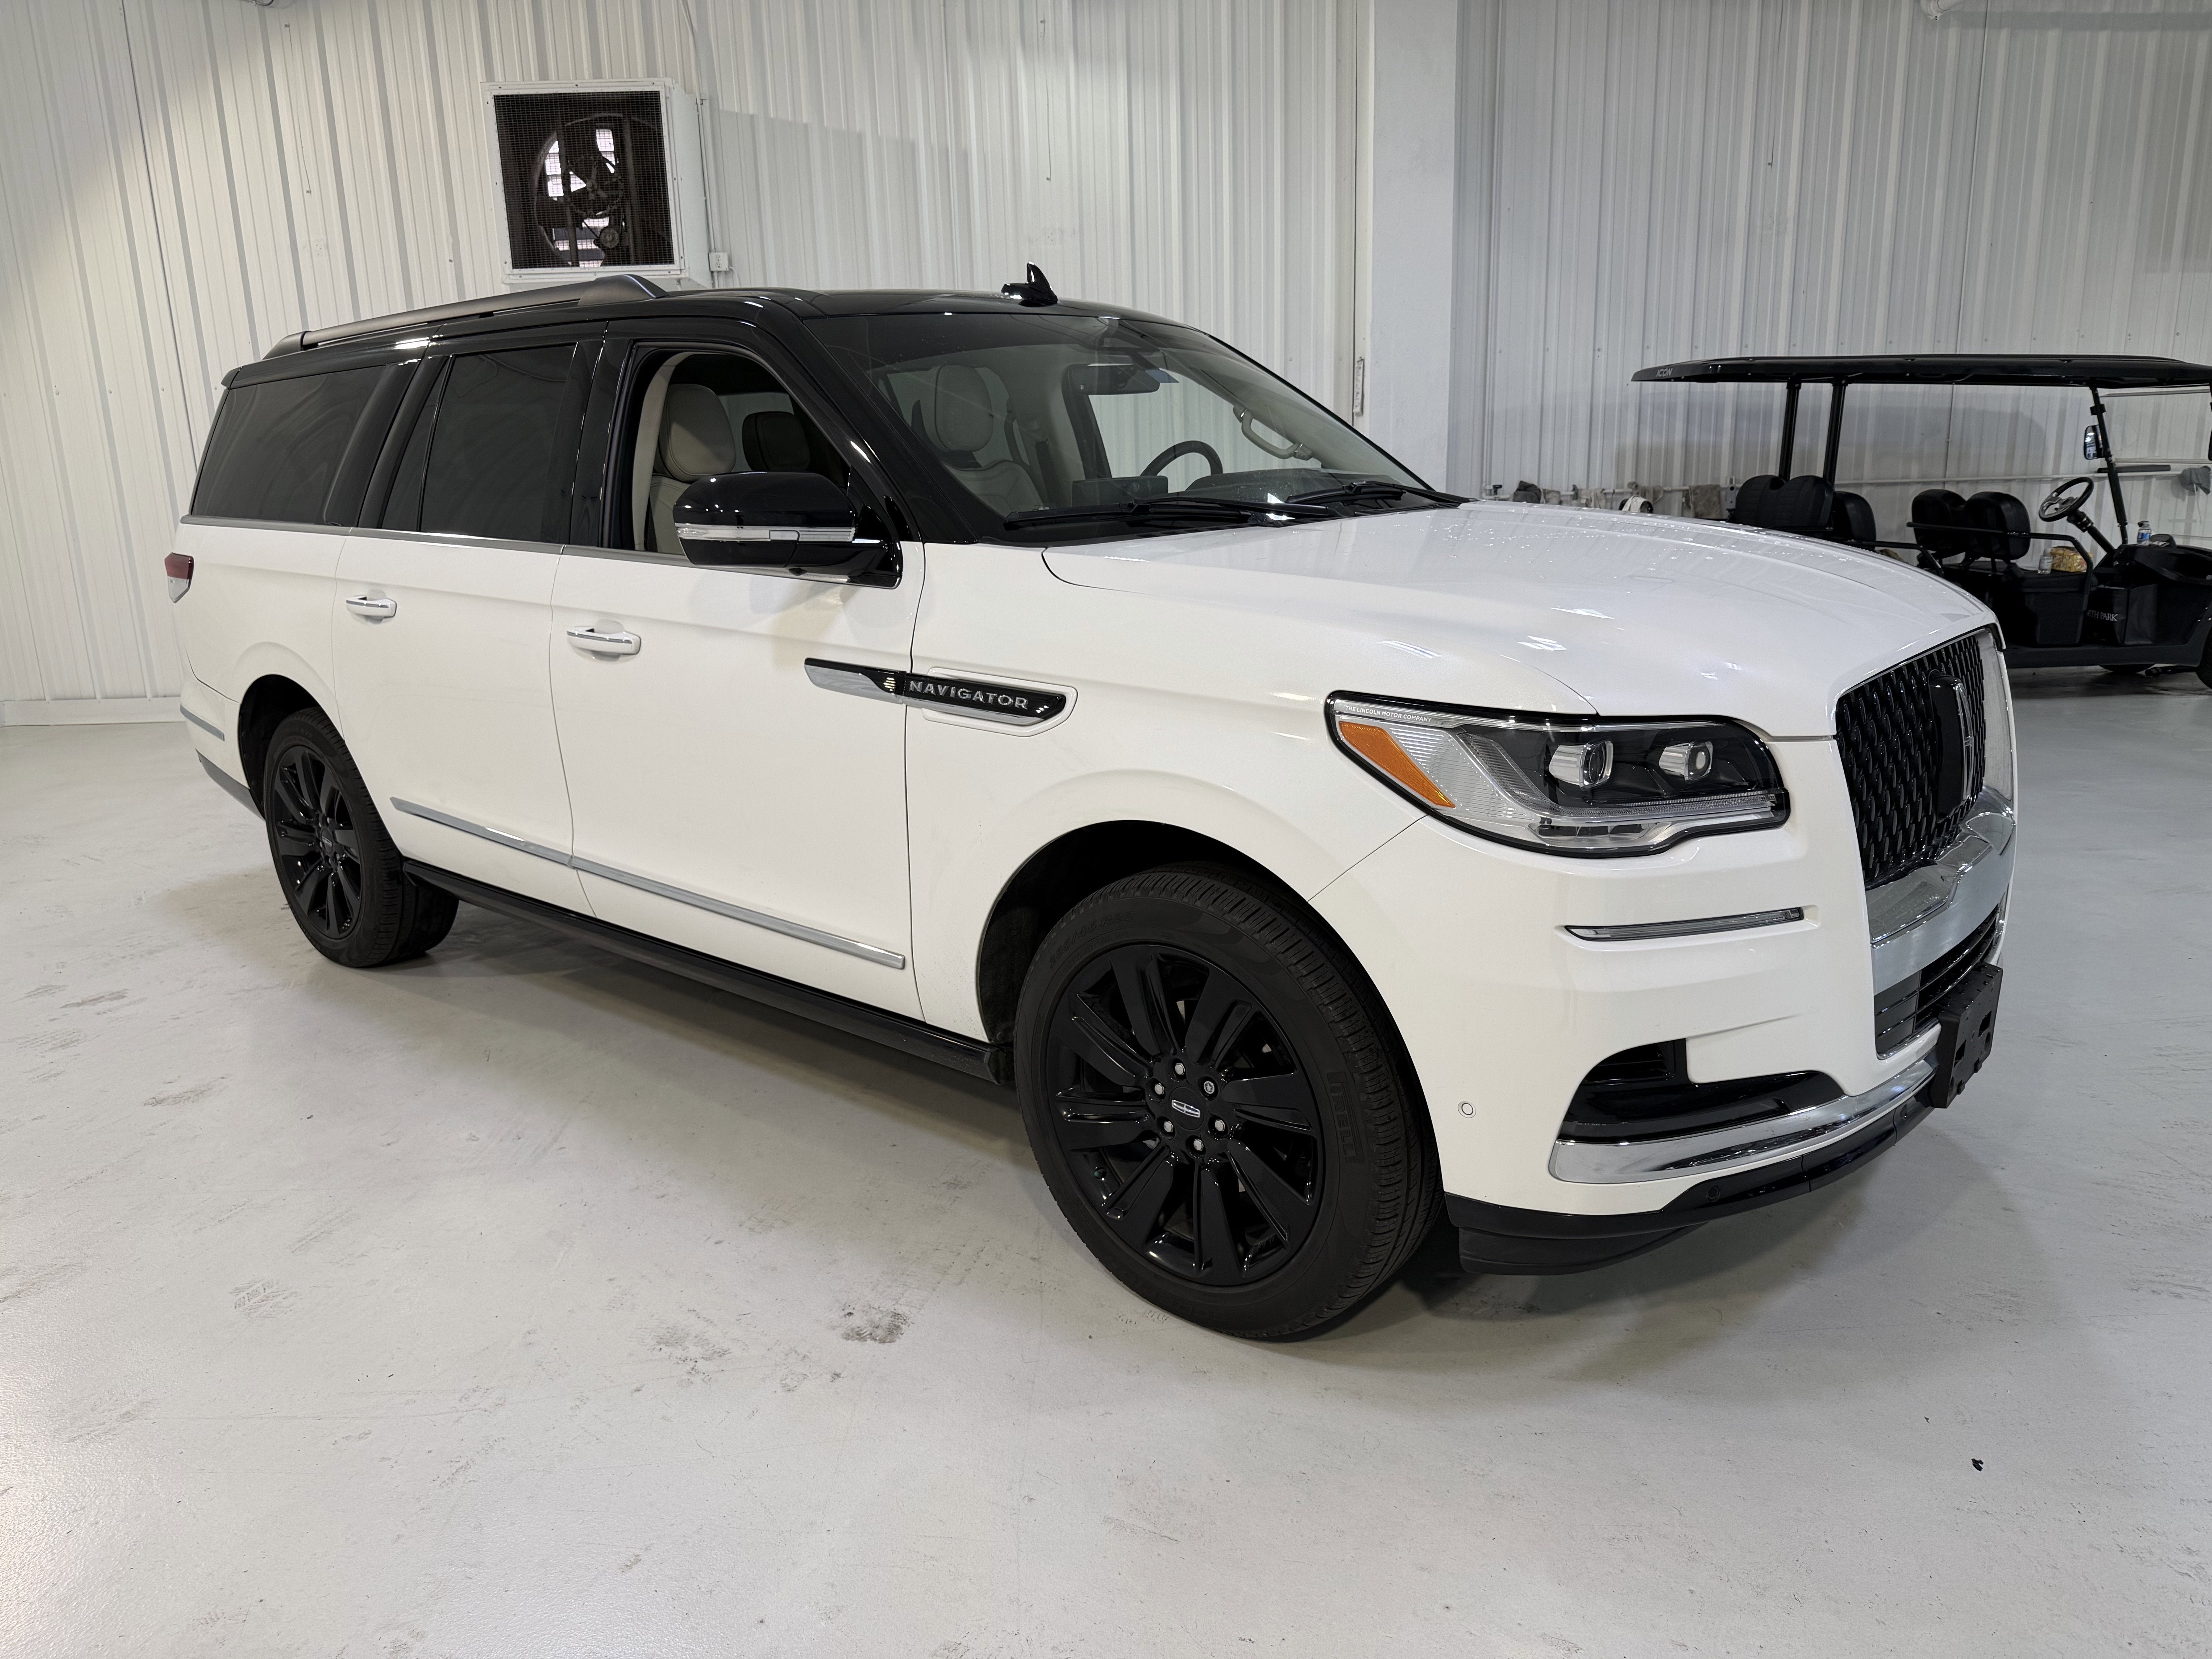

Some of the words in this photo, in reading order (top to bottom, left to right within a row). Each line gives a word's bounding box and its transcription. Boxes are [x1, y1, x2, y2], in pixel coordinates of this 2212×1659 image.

[1656, 368, 1673, 378] ICON
[2100, 612, 2118, 622] PARK
[909, 680, 1029, 710] NAVIGATOR
[1403, 714, 1432, 722] COMPANY
[1100, 911, 1134, 927] R22
[1327, 1072, 1364, 1163] PIRELLI
